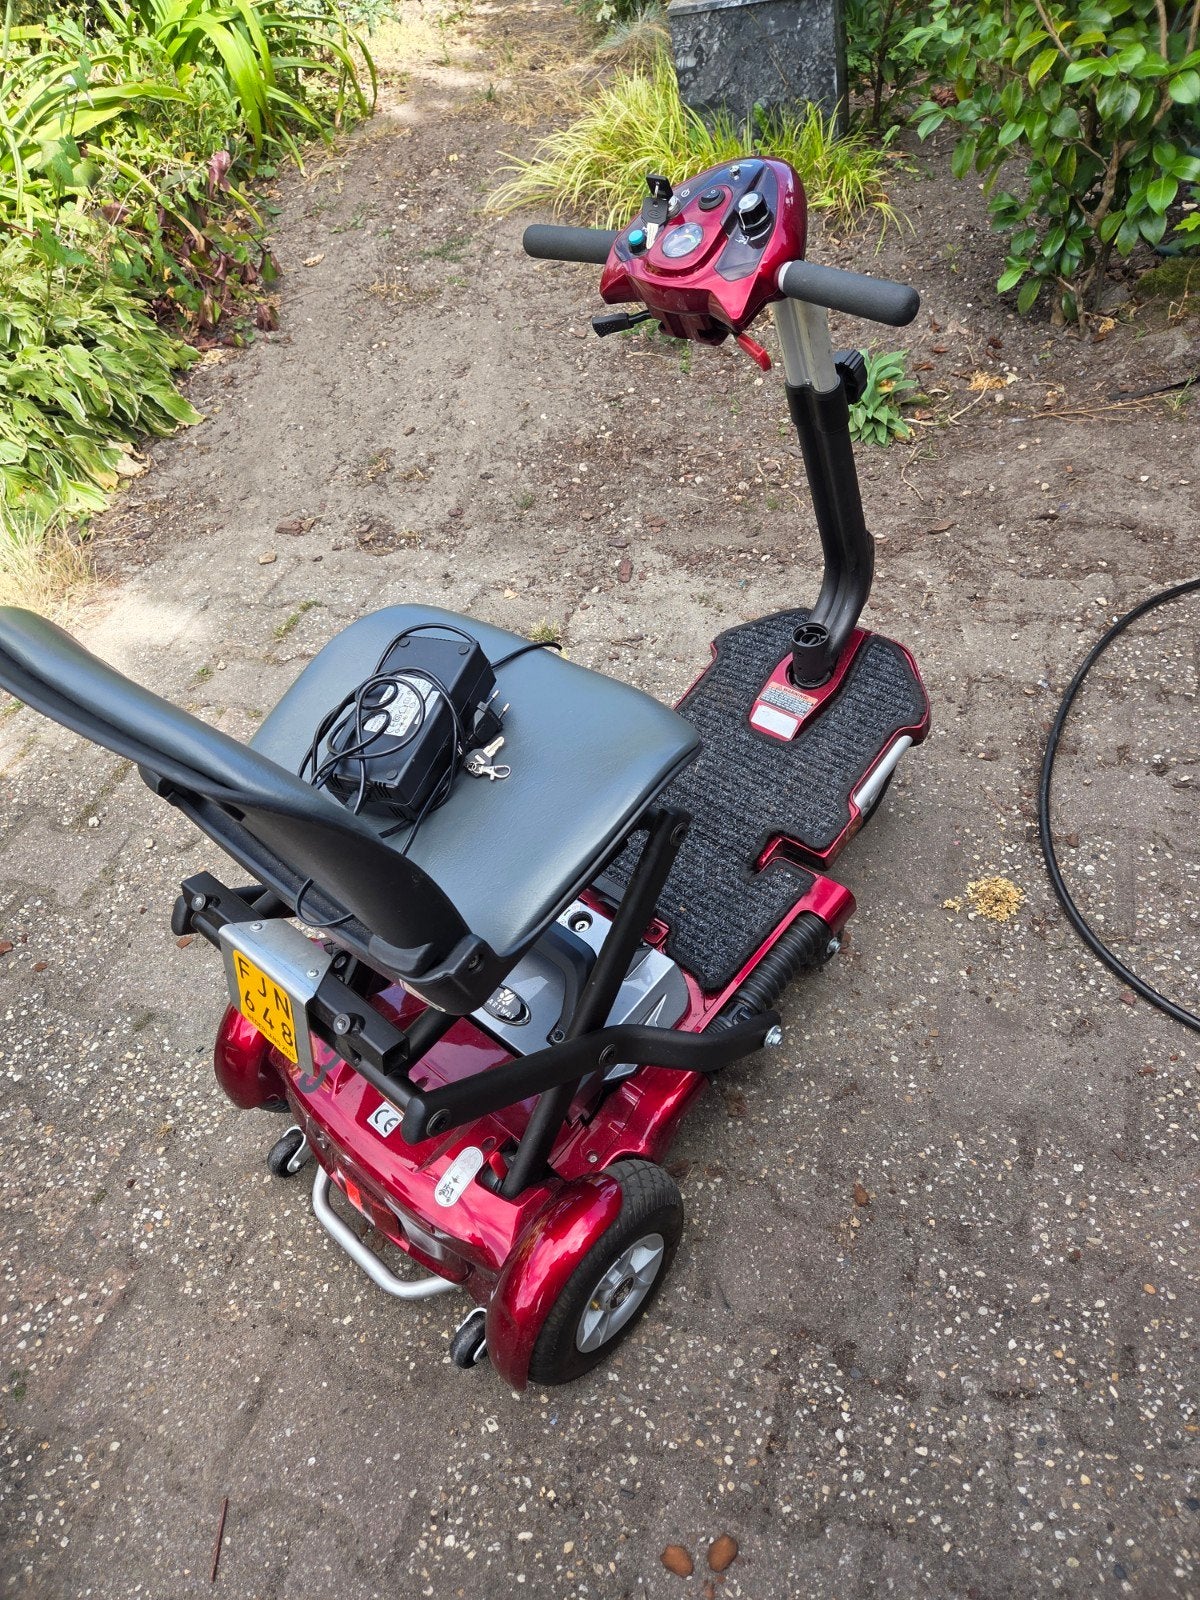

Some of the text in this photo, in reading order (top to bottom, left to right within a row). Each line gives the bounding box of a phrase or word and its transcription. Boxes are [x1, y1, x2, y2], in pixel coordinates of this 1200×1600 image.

[238, 957, 291, 1020] FJN
[486, 998, 515, 1020] ARTWAY
[244, 990, 294, 1047] 648
[374, 1108, 399, 1133] CE
